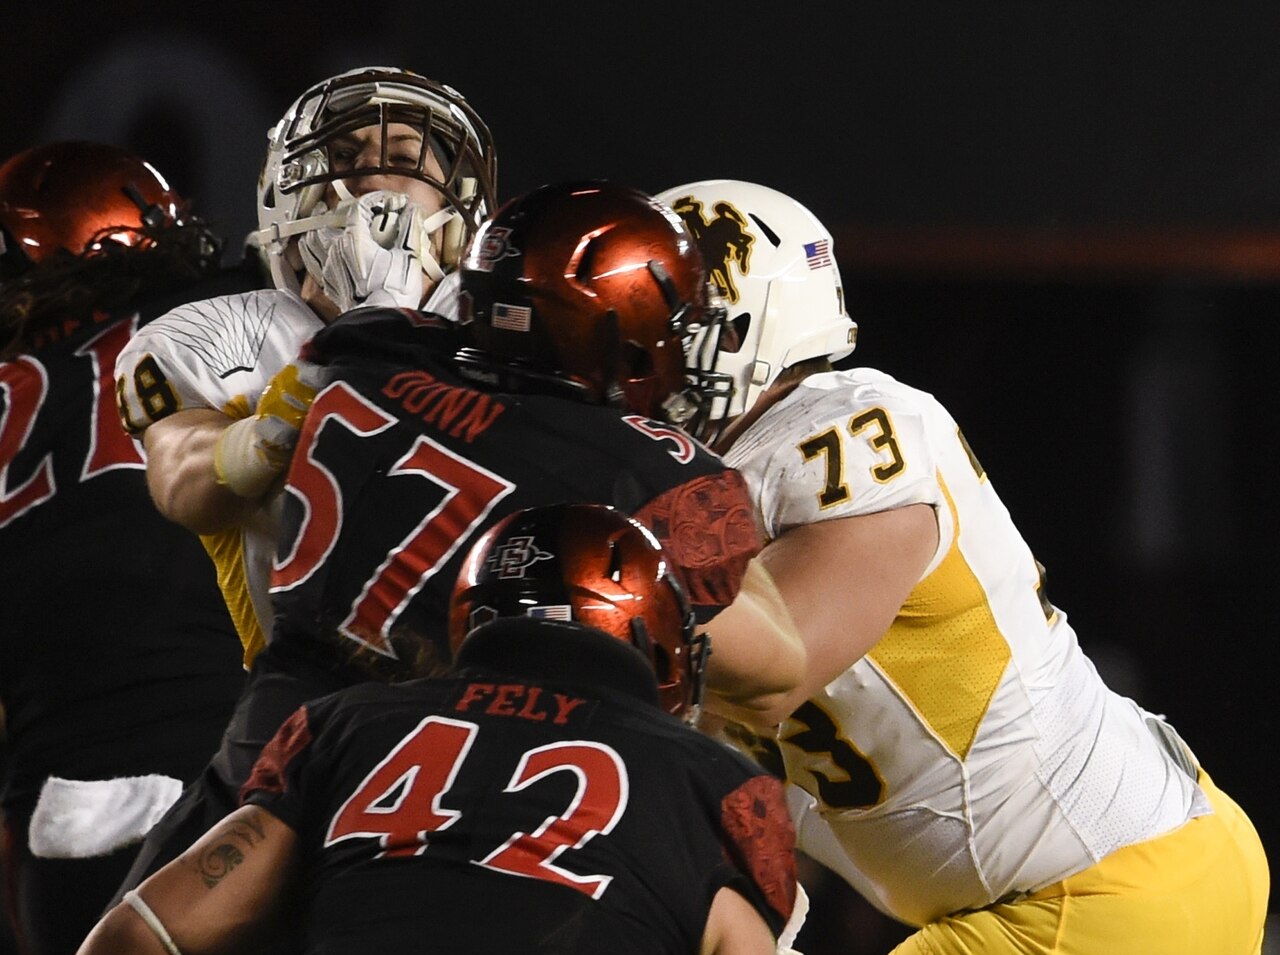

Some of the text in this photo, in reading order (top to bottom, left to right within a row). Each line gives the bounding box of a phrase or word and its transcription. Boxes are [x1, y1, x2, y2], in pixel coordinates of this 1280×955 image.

[116, 352, 182, 434] 8
[380, 370, 506, 443] DUNN
[795, 404, 906, 511] 73
[268, 380, 517, 660] 57
[455, 683, 587, 725] FELY
[323, 715, 629, 900] 42
